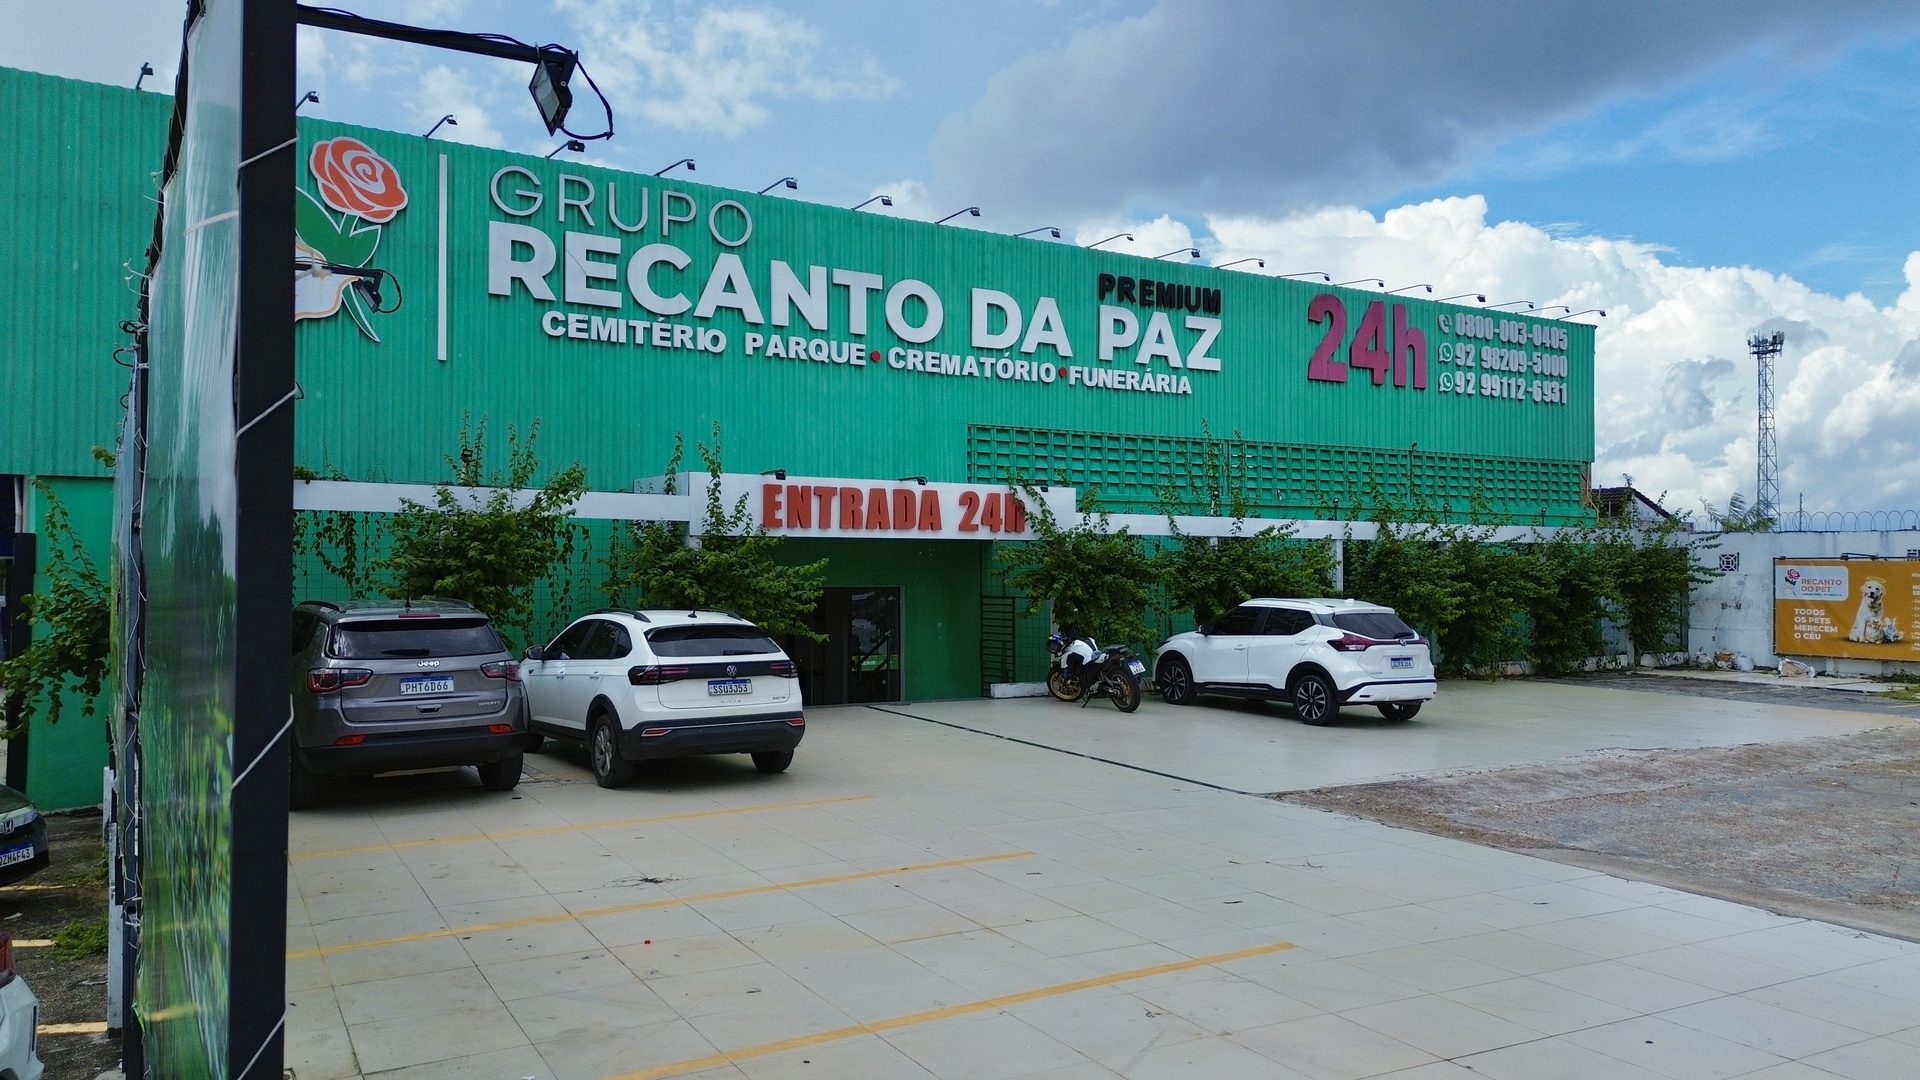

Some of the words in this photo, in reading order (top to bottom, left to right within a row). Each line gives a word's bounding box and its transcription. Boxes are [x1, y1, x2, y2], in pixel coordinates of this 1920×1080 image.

[490, 165, 753, 247] GRUPO
[488, 220, 944, 344] RECANTO
[971, 287, 1073, 357] DA
[1099, 304, 1222, 371] PAZ
[1099, 273, 1221, 314] PREMIUM
[1307, 293, 1427, 389] 24h
[1455, 312, 1568, 350] 0800-003-0405
[542, 310, 727, 354] CEMITÉRIO
[745, 331, 866, 367] PARQUE
[888, 346, 1056, 383] CREMATÓRIO
[1068, 365, 1192, 395] FUNERÁRIA
[1455, 342, 1475, 367] 92
[1481, 345, 1568, 378] 98209-5000
[1455, 371, 1475, 395] 92
[1481, 373, 1568, 405] 99112-6931
[762, 483, 942, 531] ENTRADA
[1801, 578, 1842, 586] RECANTO
[1794, 608, 1825, 616] TODOS
[1794, 624, 1838, 633] MERECEM
[1803, 631, 1821, 640] CÉU
[417, 659, 440, 668] Jeep
[405, 681, 448, 693] PHT6D66
[713, 684, 748, 694] SSU3J53
